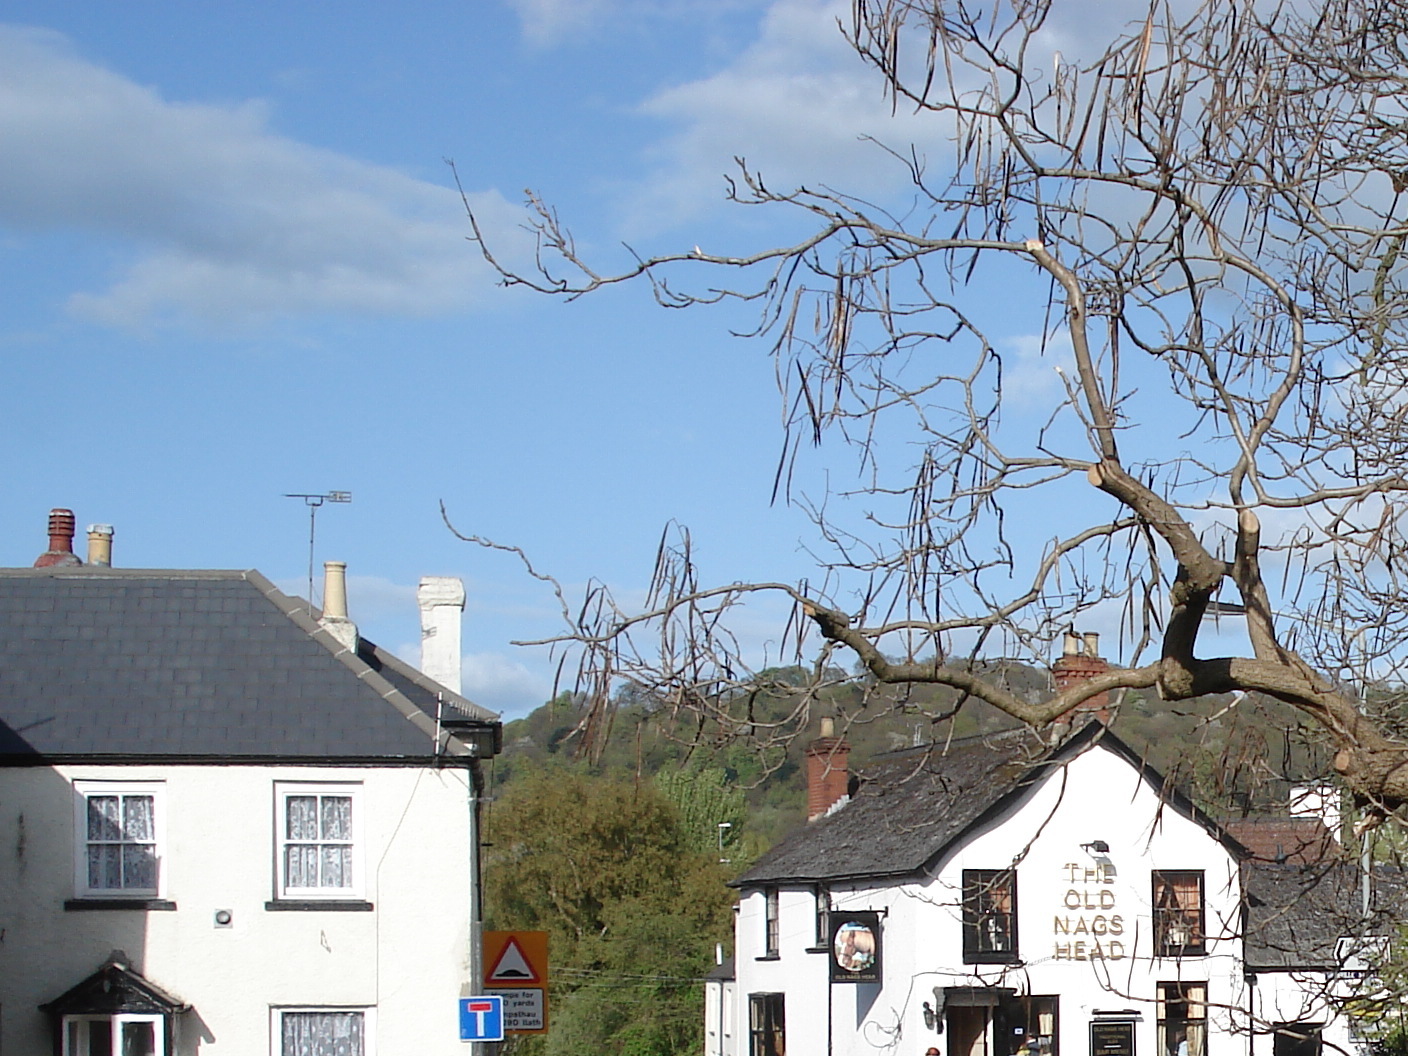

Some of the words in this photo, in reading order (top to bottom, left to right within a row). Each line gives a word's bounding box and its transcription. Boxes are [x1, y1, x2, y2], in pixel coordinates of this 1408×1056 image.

[1064, 863, 1114, 884] THE
[1064, 889, 1115, 910] OLD
[1054, 915, 1123, 936] NAGS
[1055, 941, 1124, 961] HEAD
